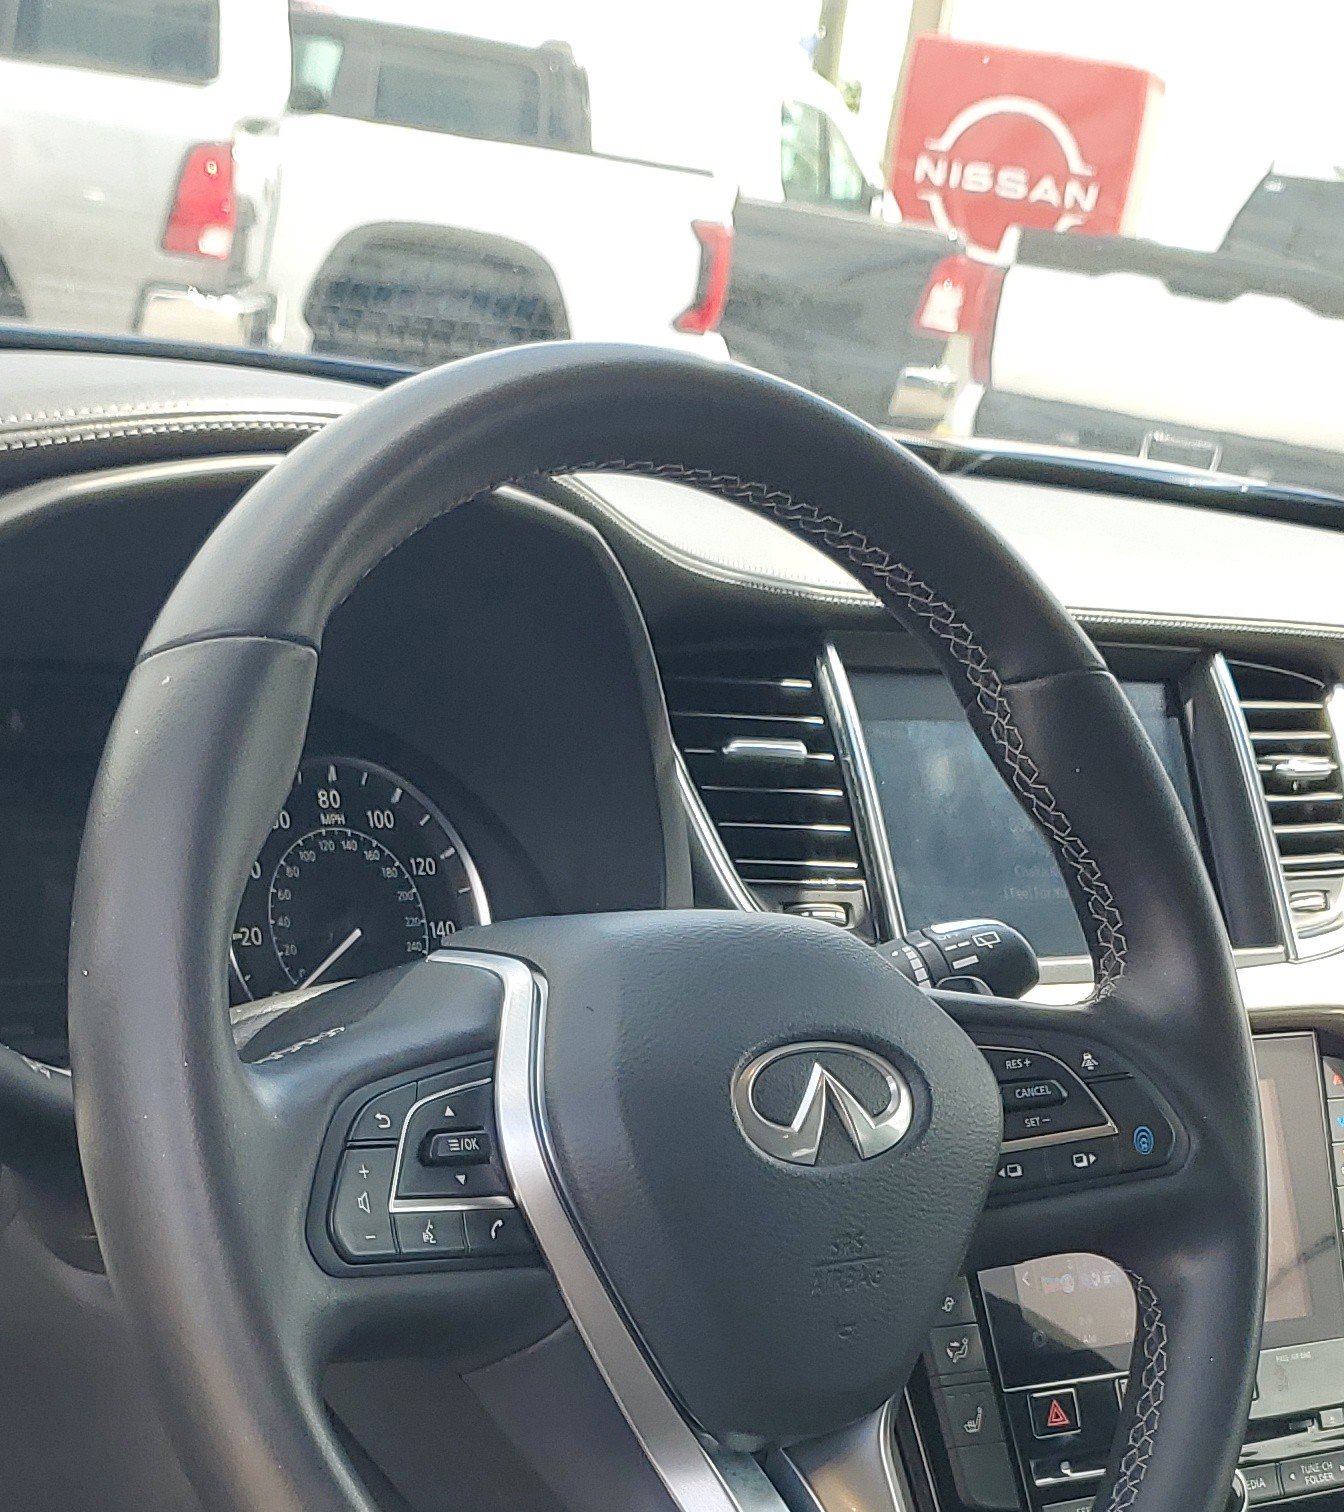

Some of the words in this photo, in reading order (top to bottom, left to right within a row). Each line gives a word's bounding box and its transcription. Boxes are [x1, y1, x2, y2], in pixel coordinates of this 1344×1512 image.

[914, 153, 1099, 214] NISSAN
[317, 789, 341, 809] 80
[321, 813, 345, 825] MPH
[367, 810, 394, 829] 100
[410, 857, 436, 876] 120
[240, 928, 262, 946] 20
[429, 921, 456, 938] 140
[1015, 1085, 1052, 1099] CANCEL
[1247, 1477, 1266, 1491] EDIA
